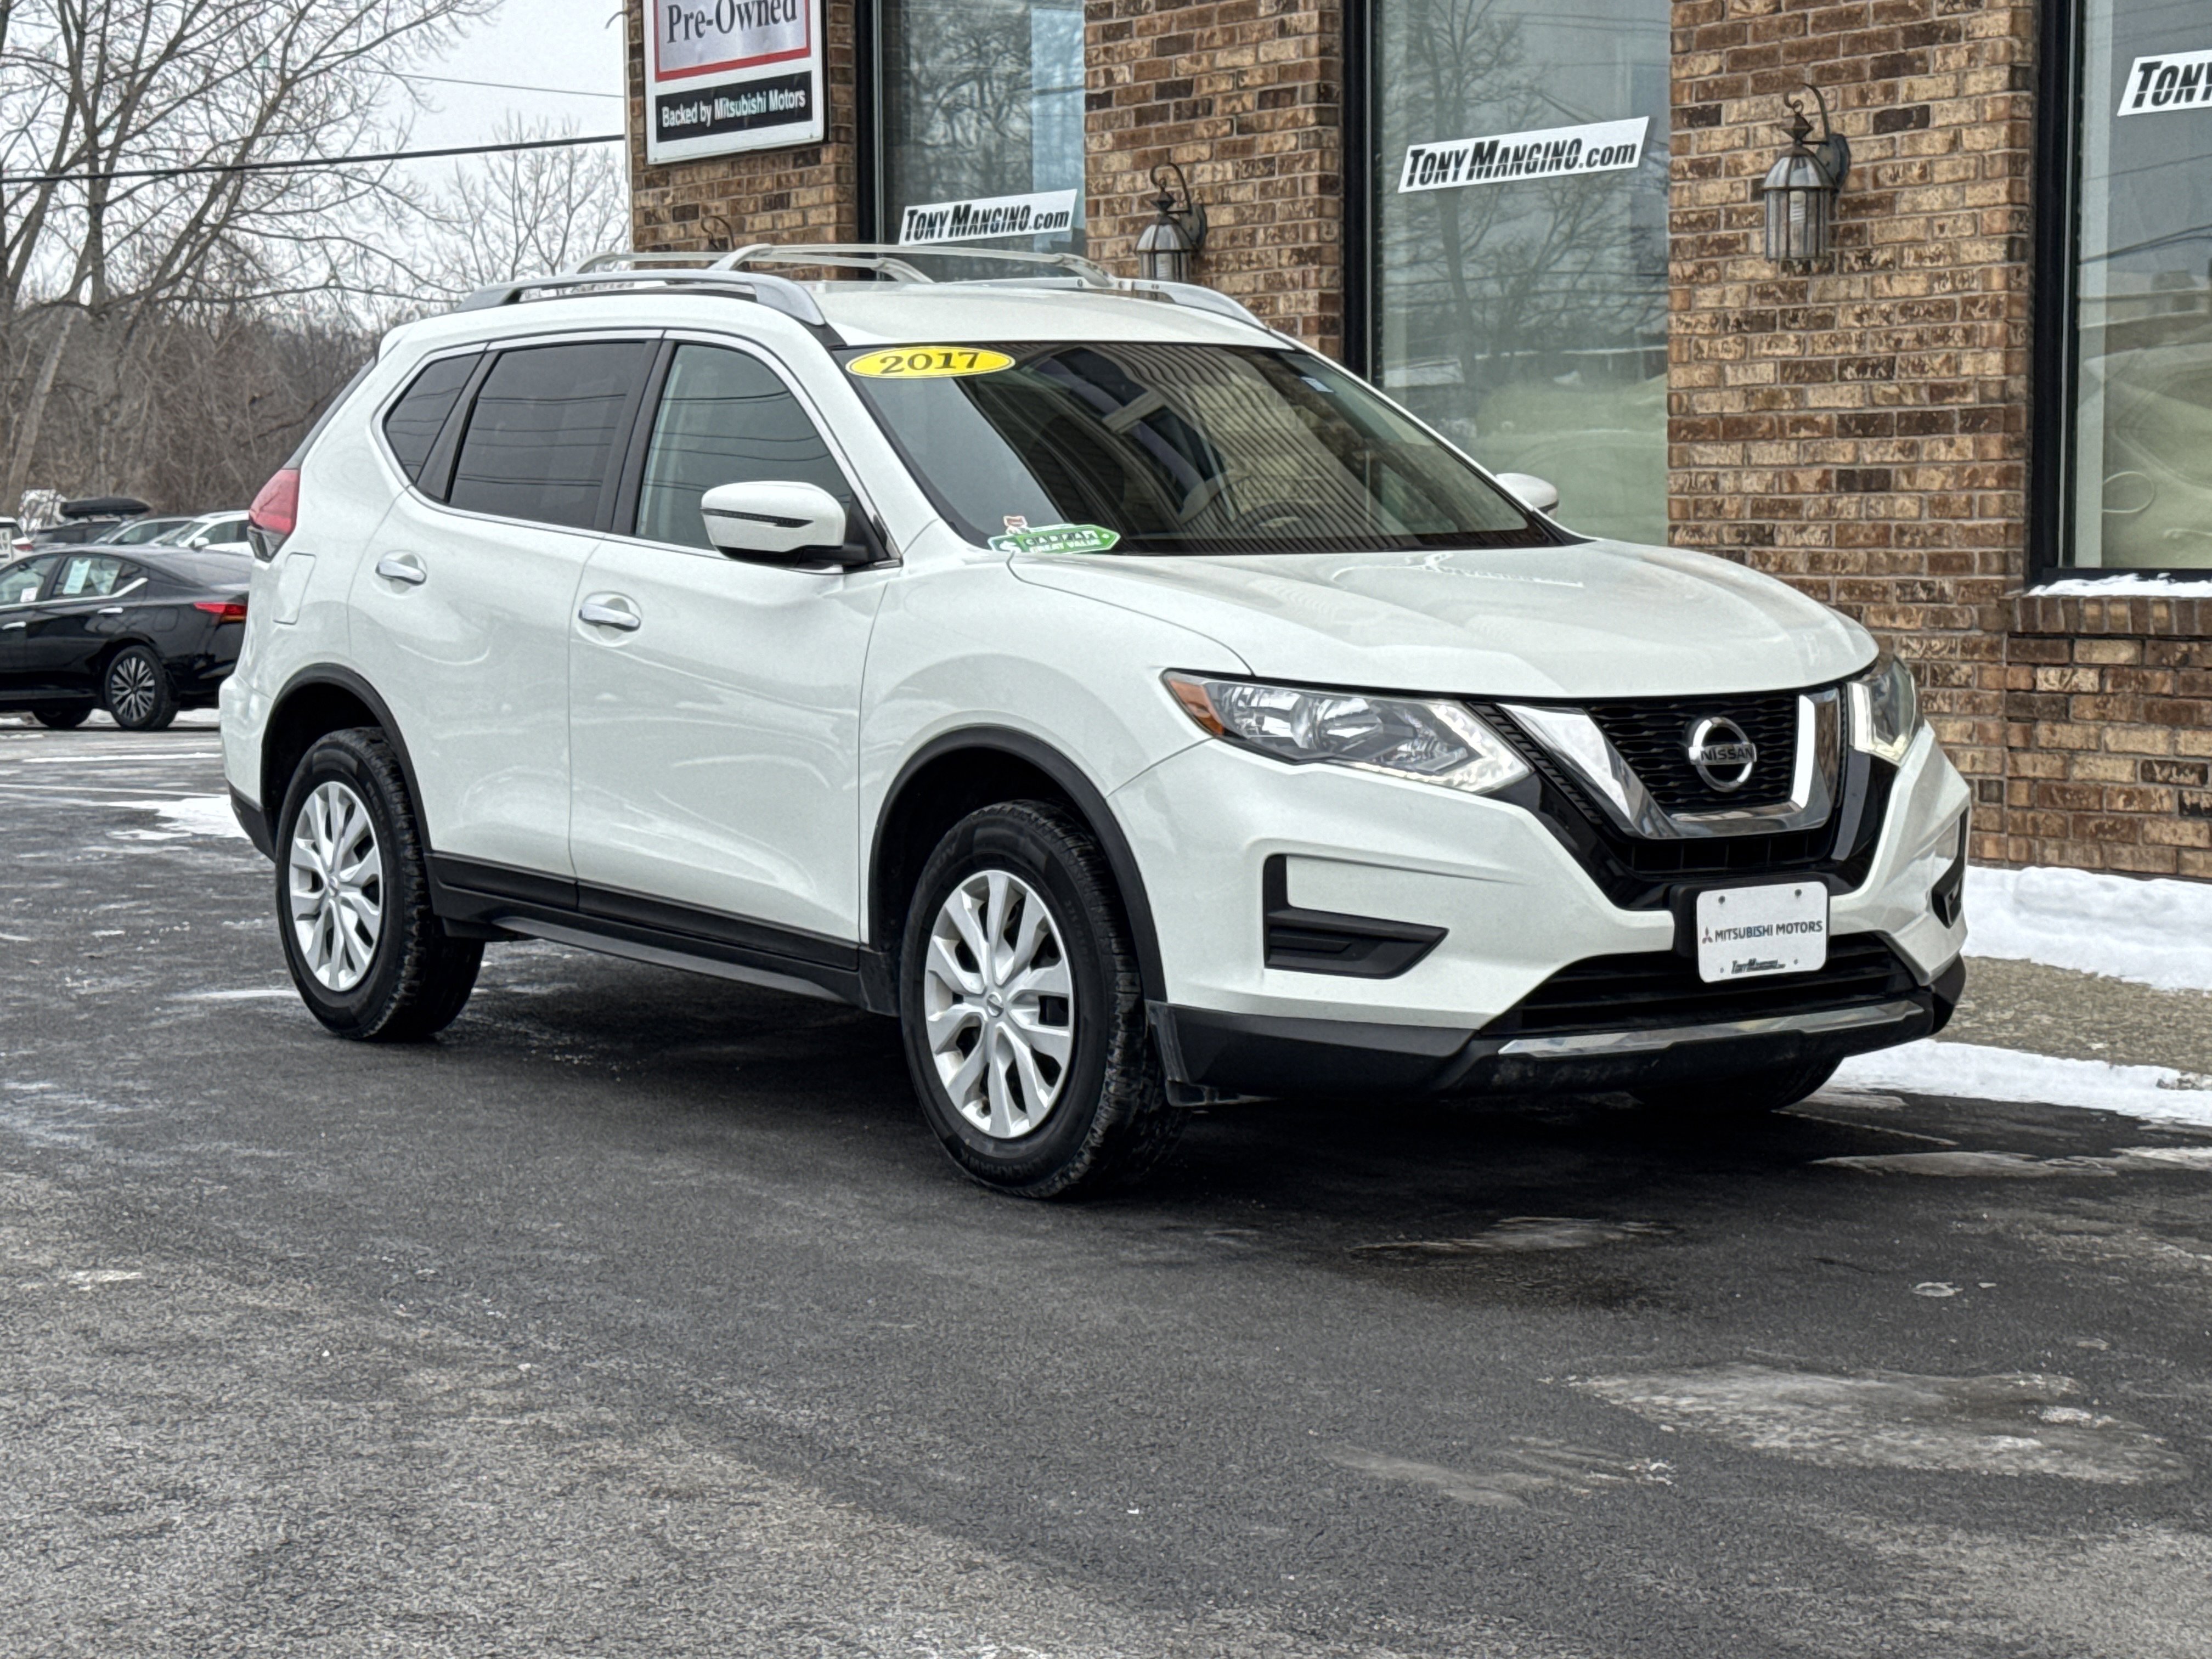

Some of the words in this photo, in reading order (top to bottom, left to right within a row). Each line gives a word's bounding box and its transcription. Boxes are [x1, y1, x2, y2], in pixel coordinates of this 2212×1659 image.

[667, 0, 798, 43] Pre-Owned
[662, 101, 698, 128] Backed
[699, 100, 712, 127] by
[714, 91, 767, 121] Mitsubishi
[769, 88, 806, 112] Motors
[879, 352, 979, 374] 2017
[1701, 747, 1755, 761] NISSAN
[1714, 924, 1773, 943] MITSUBISHI
[1776, 920, 1823, 936] MOTORS
